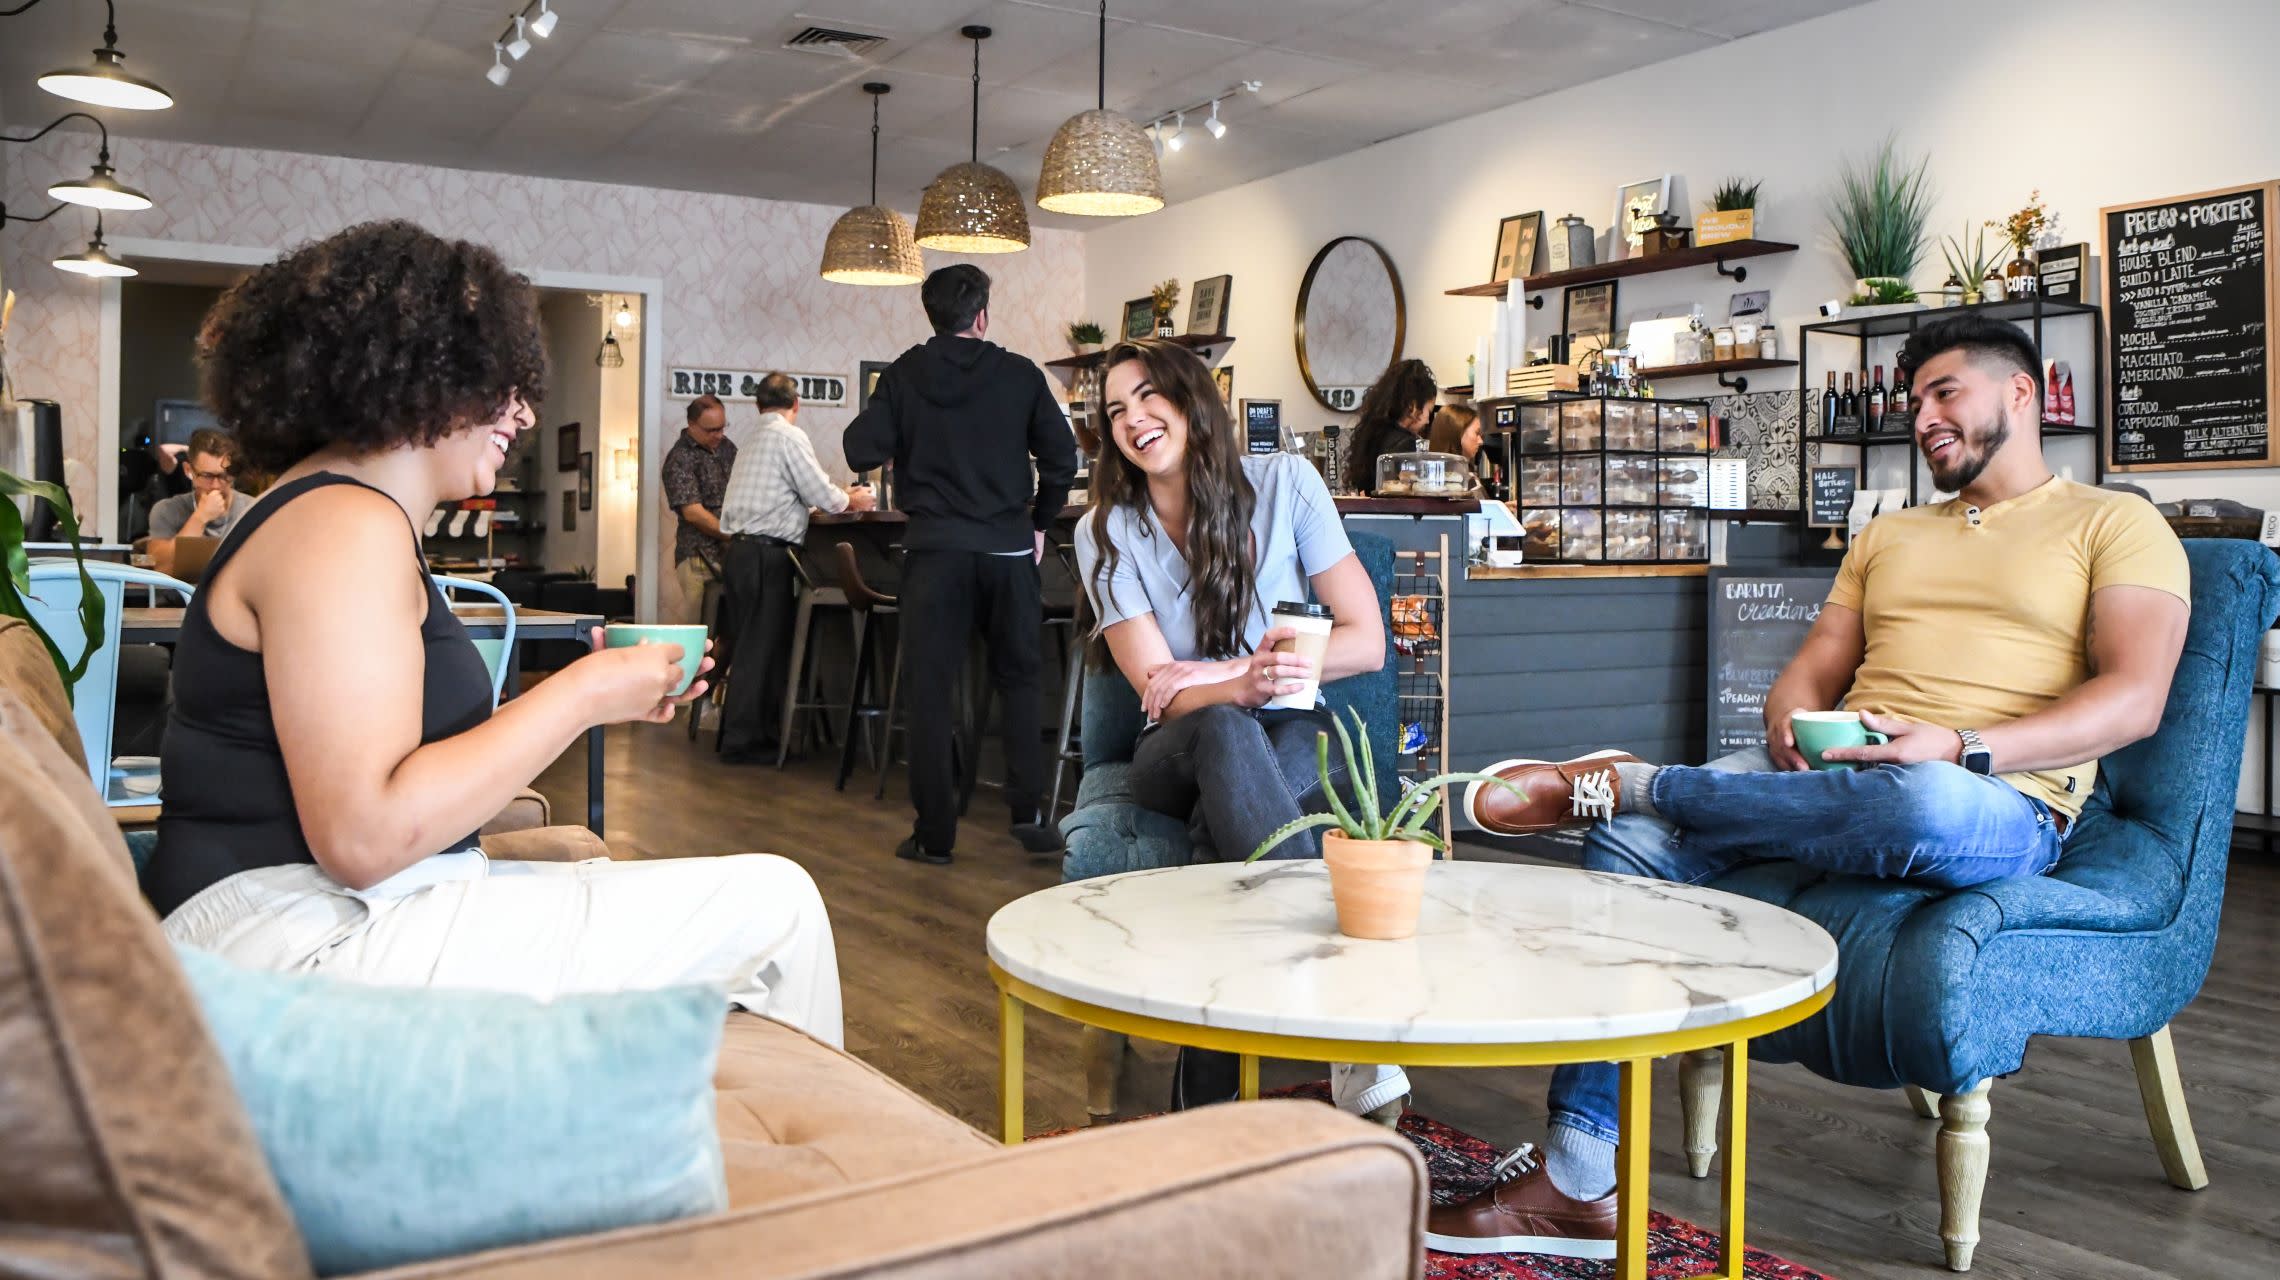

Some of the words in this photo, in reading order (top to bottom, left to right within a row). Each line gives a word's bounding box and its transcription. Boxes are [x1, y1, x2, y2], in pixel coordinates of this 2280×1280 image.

[2189, 196, 2255, 228] PORTER
[2119, 254, 2152, 273] HOUSE
[2157, 245, 2197, 267] BLEND
[2119, 271, 2151, 288] BUILD
[2162, 264, 2195, 283] LATTE
[2120, 331, 2158, 347] MOCHA
[2120, 352, 2183, 369] MACCHIATO
[2120, 366, 2184, 384] AMERICANO
[673, 371, 732, 396] RISE
[740, 375, 759, 397] &
[790, 376, 844, 401] IND
[2118, 402, 2159, 416] CORTADO
[2118, 415, 2180, 430] CAPPUCCINO
[2183, 428, 2208, 442] MILK
[1815, 472, 1838, 481] HALF
[1726, 583, 1784, 600] BARISTA
